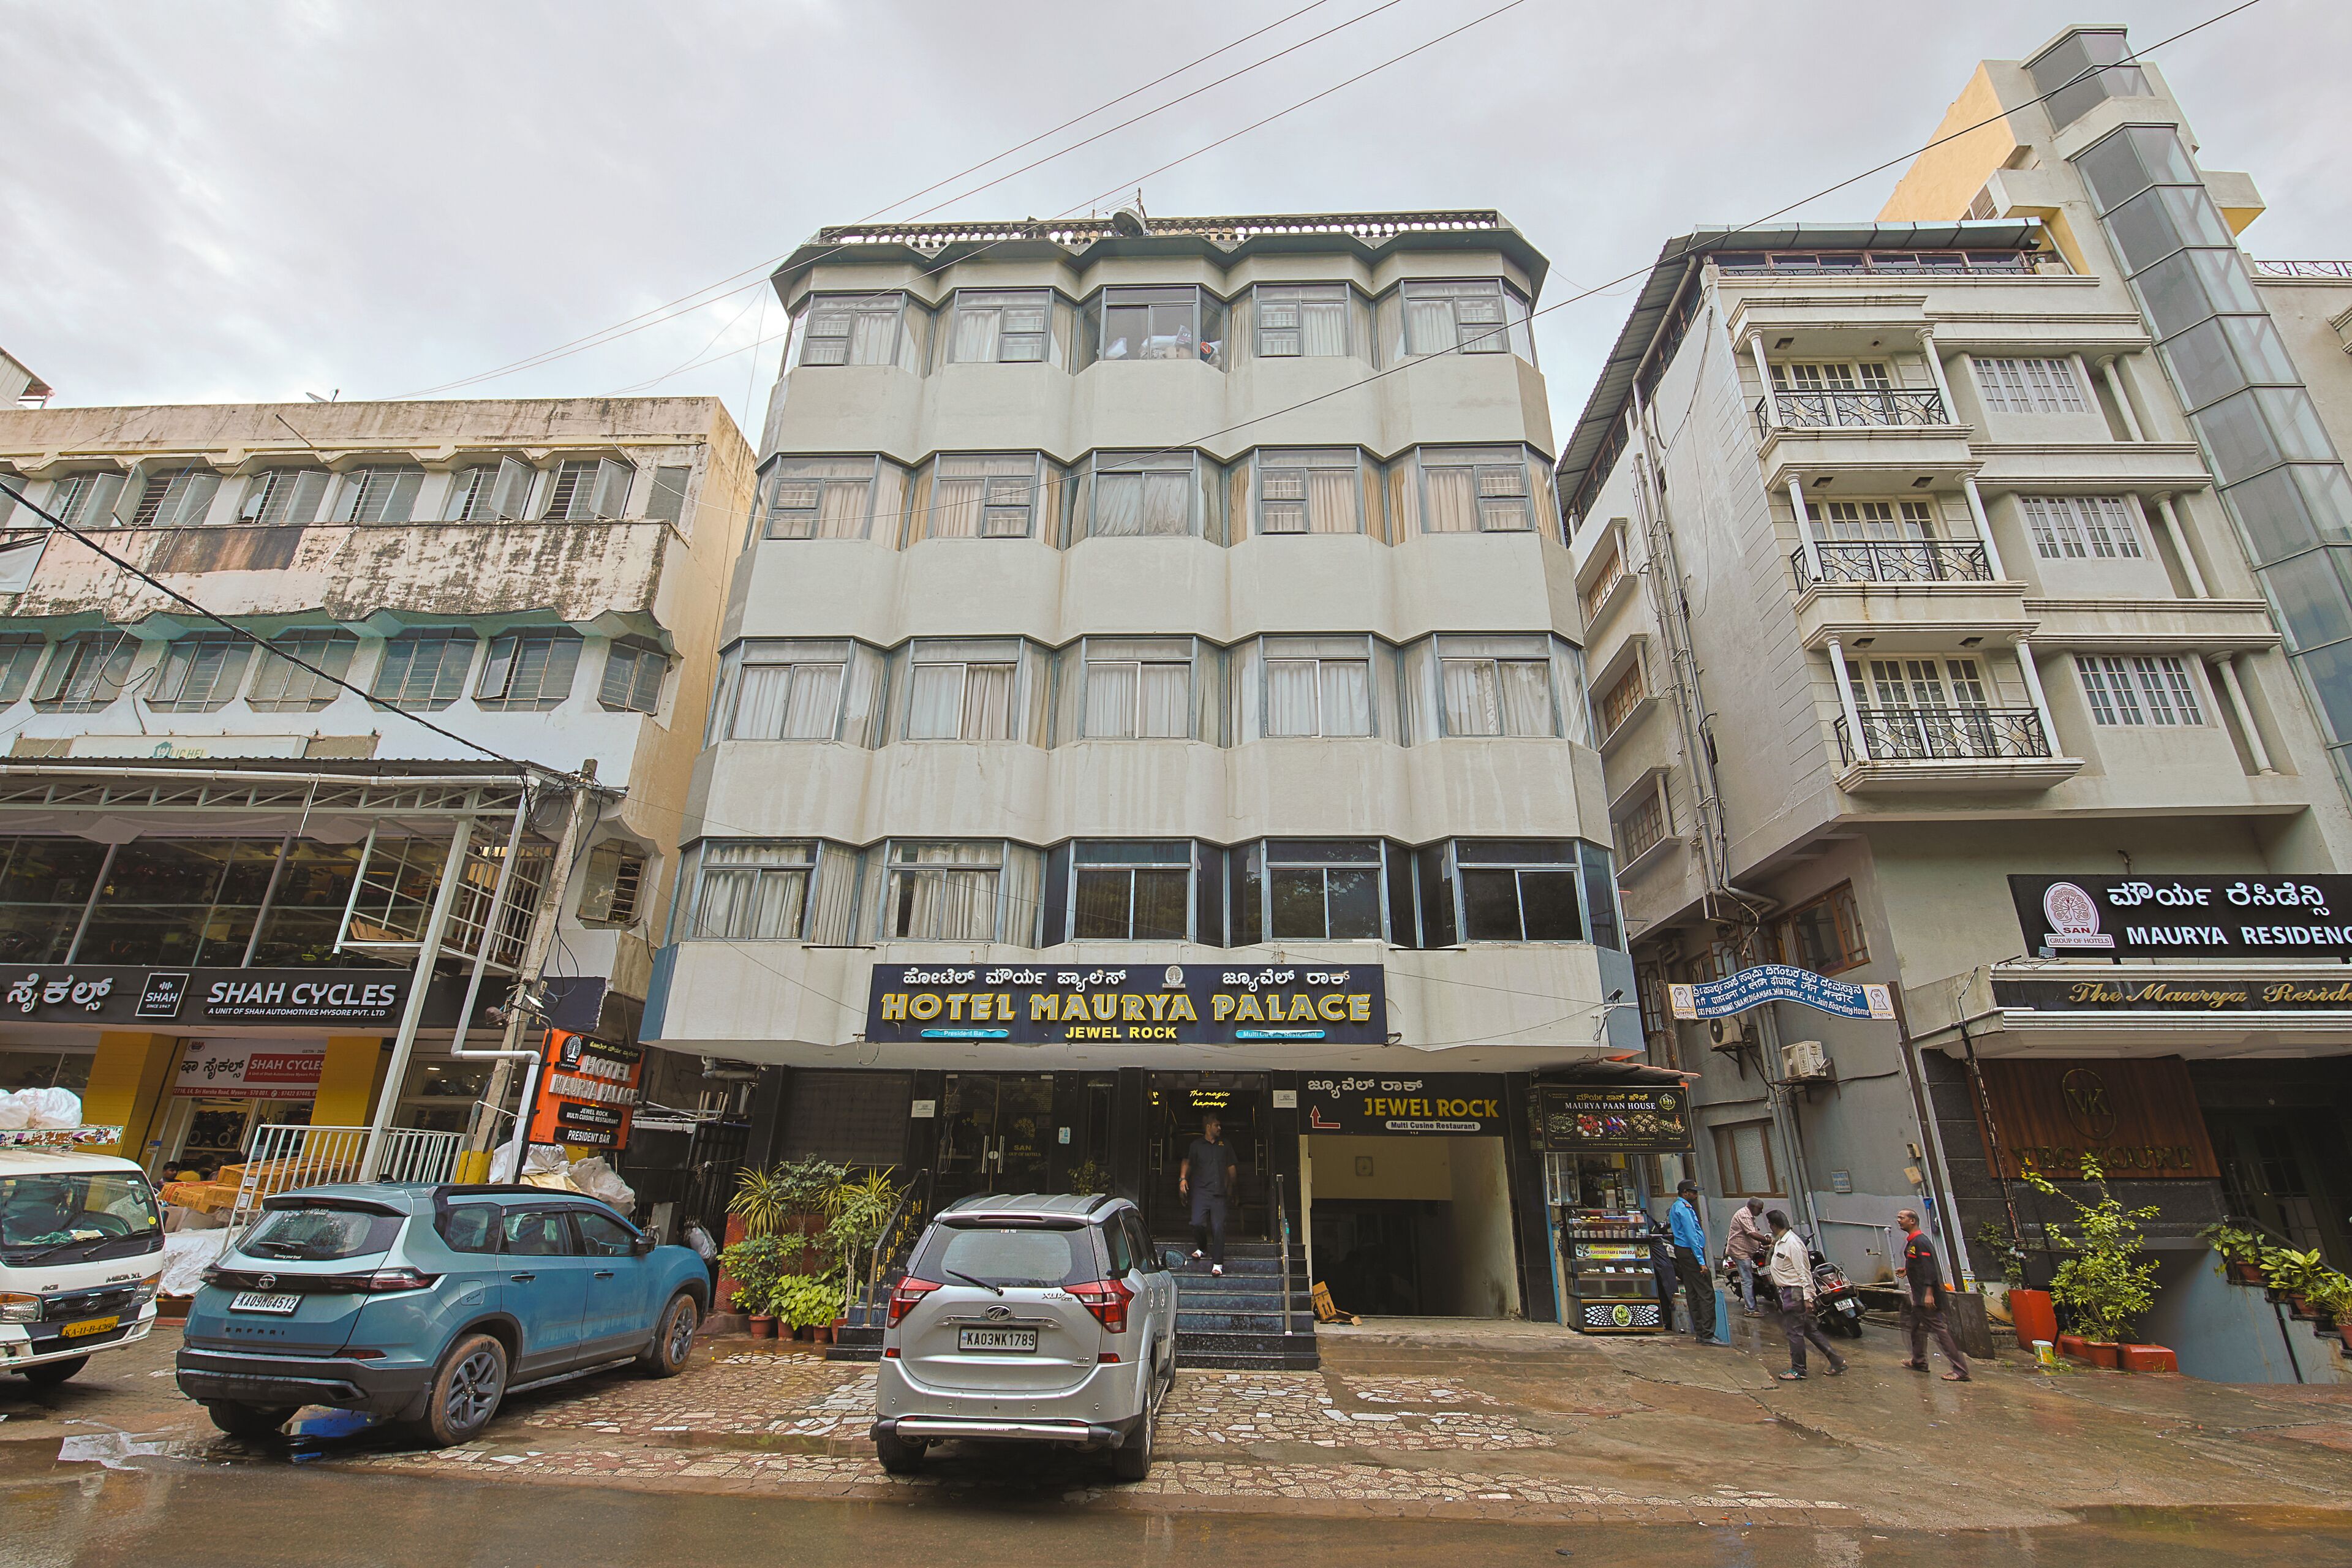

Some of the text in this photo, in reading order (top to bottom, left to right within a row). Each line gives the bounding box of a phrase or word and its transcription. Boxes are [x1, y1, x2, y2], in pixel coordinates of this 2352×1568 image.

[2107, 882, 2212, 906] ಮೌರ್ಯ
[2126, 927, 2229, 944] MAURYA
[986, 968, 1047, 984] ಮೌರ್ಯ
[145, 992, 178, 1002] SHAH
[206, 982, 396, 1006] SHAH CYCLES
[2069, 983, 2122, 1003] The
[2127, 983, 2248, 1008] Maurya
[881, 993, 1371, 1021] HOTEL MAURYA PALACE
[1734, 996, 1749, 1008] SWAMY
[1828, 1001, 1853, 1016] Boarding
[1853, 1006, 1869, 1016] Home
[1065, 1027, 1177, 1039] JEWEL ROCK
[250, 1059, 325, 1071] SHAH CYCLES
[580, 1055, 632, 1082] HOTEL
[549, 1074, 639, 1106] MAURYA PALACE
[1381, 1080, 1423, 1091] ರಾಕ್
[1364, 1098, 1499, 1118] JEWEL ROCK
[567, 1130, 611, 1144] PRESIDENT BAR
[106, 1274, 130, 1283] MEGA
[967, 1332, 1035, 1346] KA03NK1789
